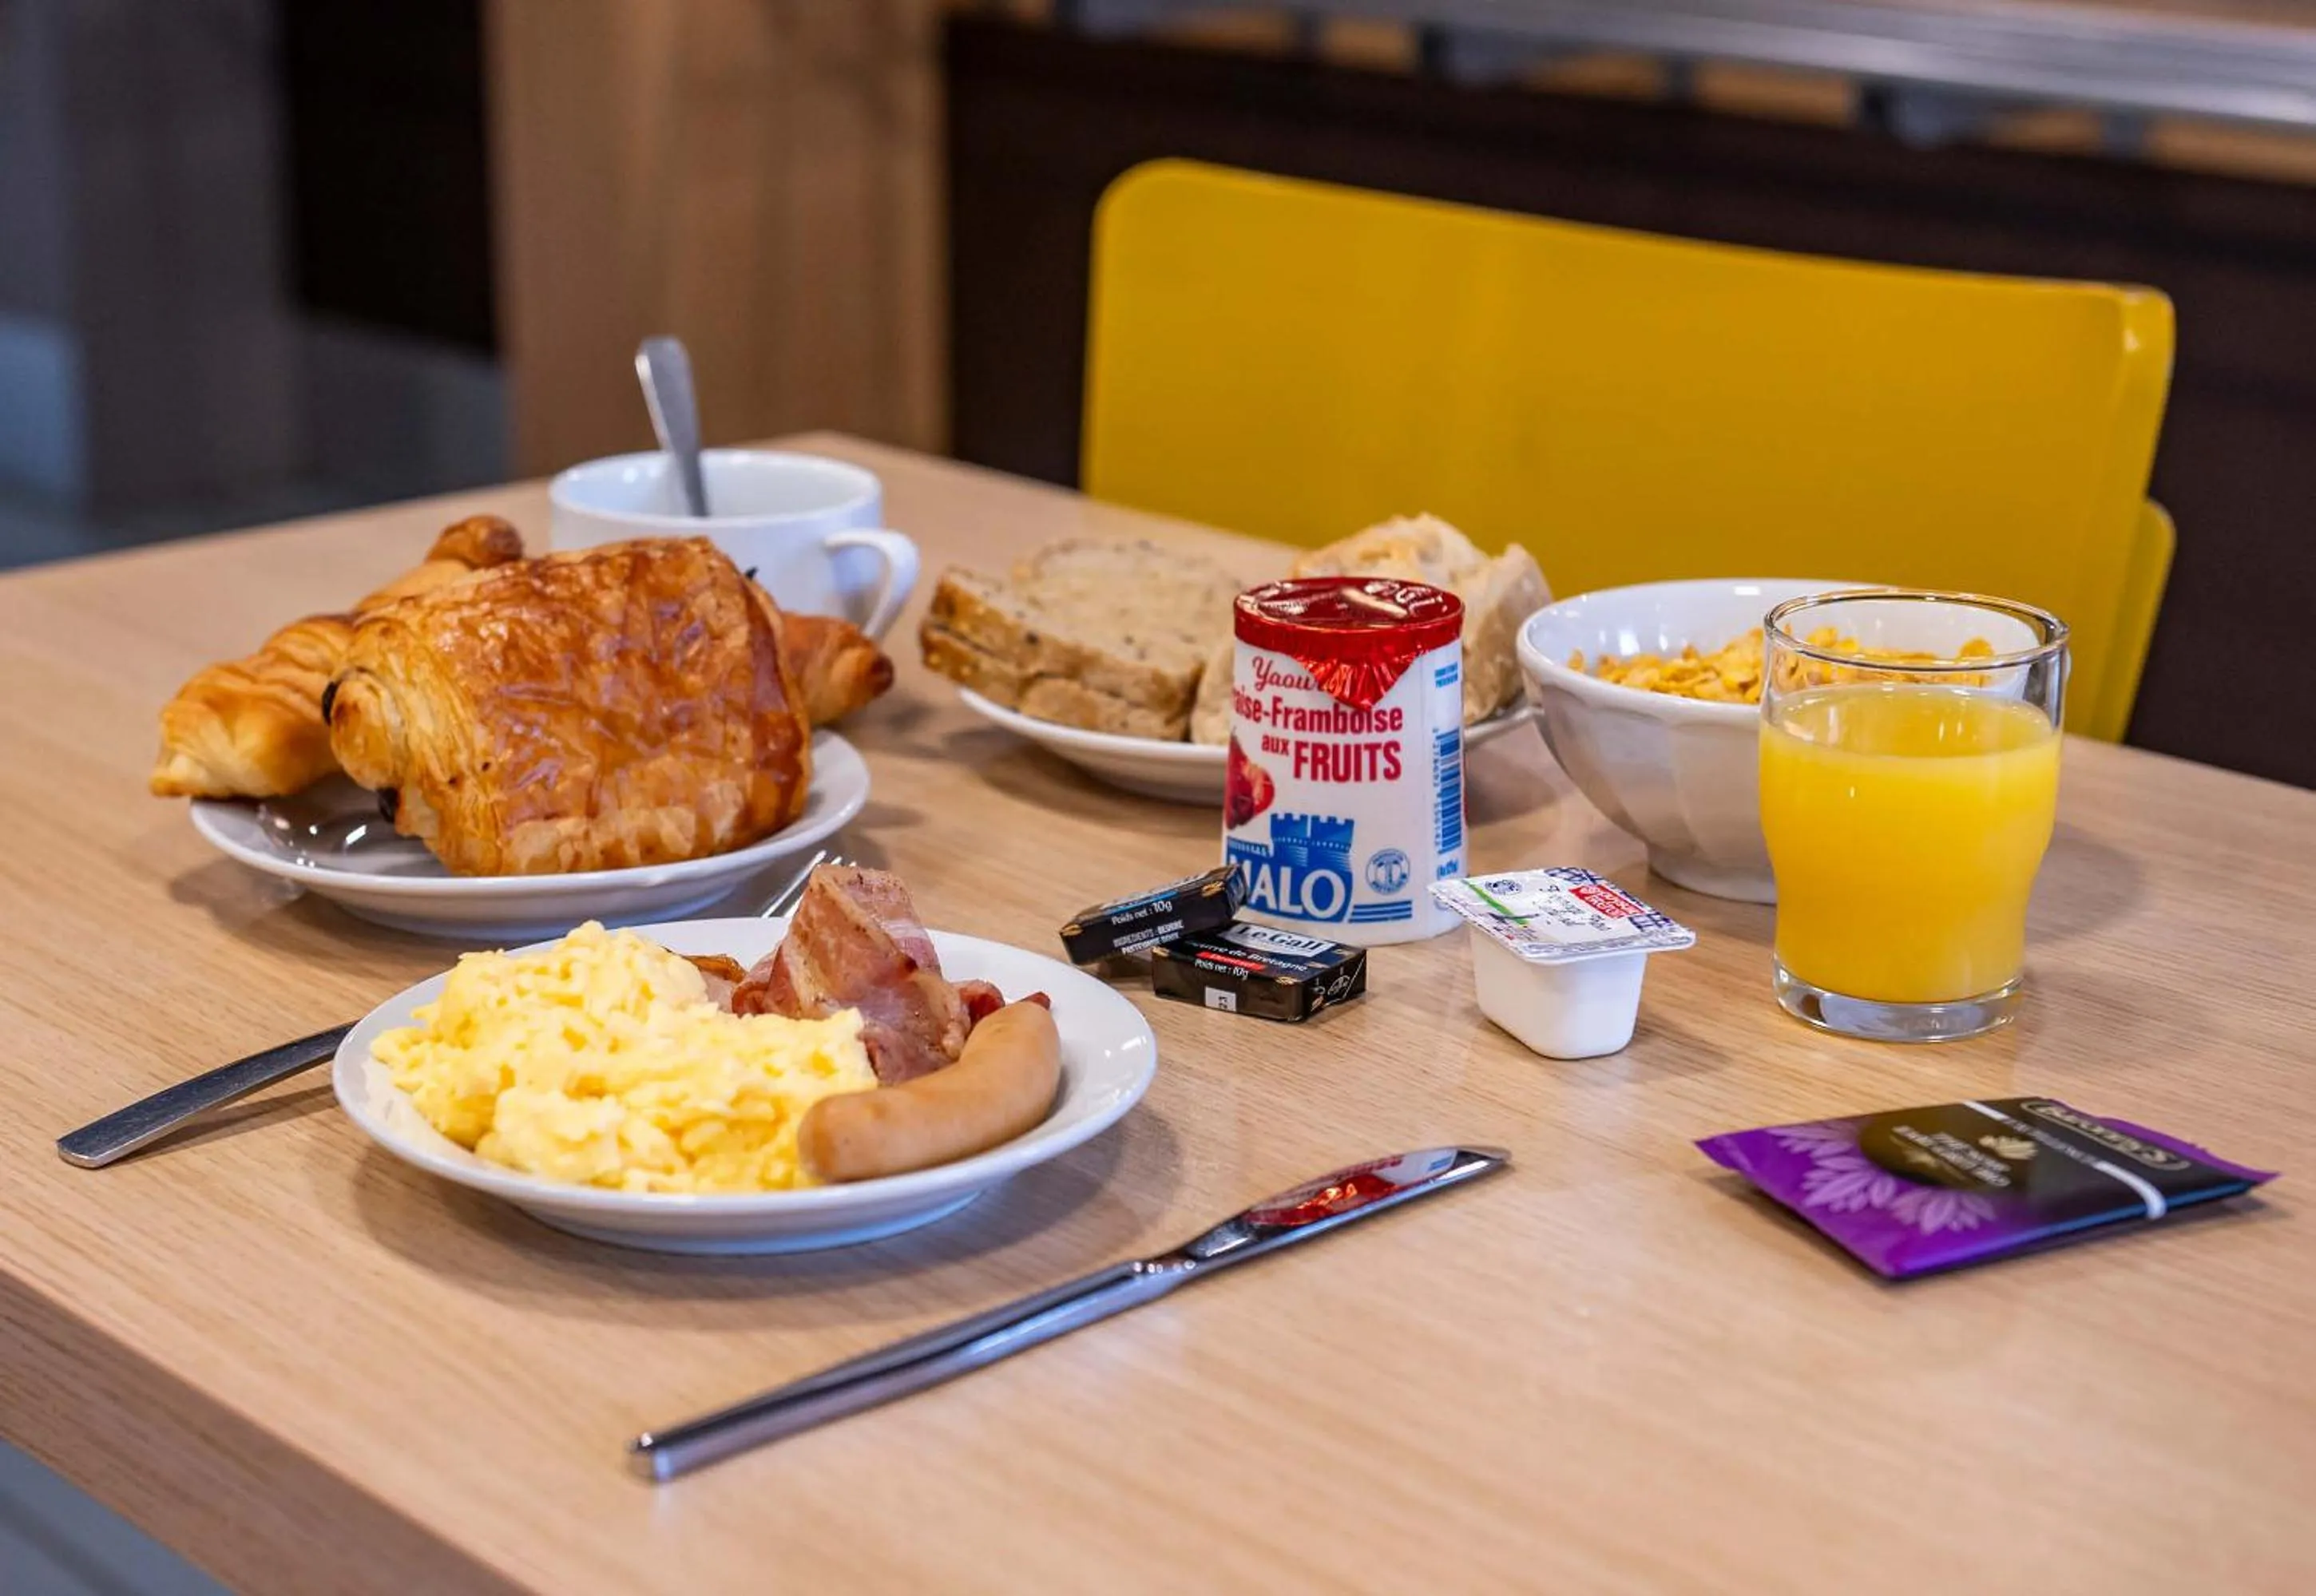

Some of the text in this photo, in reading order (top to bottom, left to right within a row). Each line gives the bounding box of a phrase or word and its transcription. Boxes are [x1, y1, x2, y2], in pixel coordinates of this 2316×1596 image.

[1252, 655, 1319, 692] Yaou
[1262, 735, 1402, 783] aux FRUITS
[1111, 913, 1134, 925] Poids
[1134, 908, 1148, 918] net
[1152, 900, 1173, 913] 10g
[1238, 925, 1267, 938] Le
[1268, 933, 1325, 951] Gall
[1195, 959, 1214, 971] Poids
[1214, 964, 1227, 973] net
[1232, 967, 1249, 981] 10g
[1228, 948, 1247, 958] de
[1247, 953, 1309, 972] Bretagne
